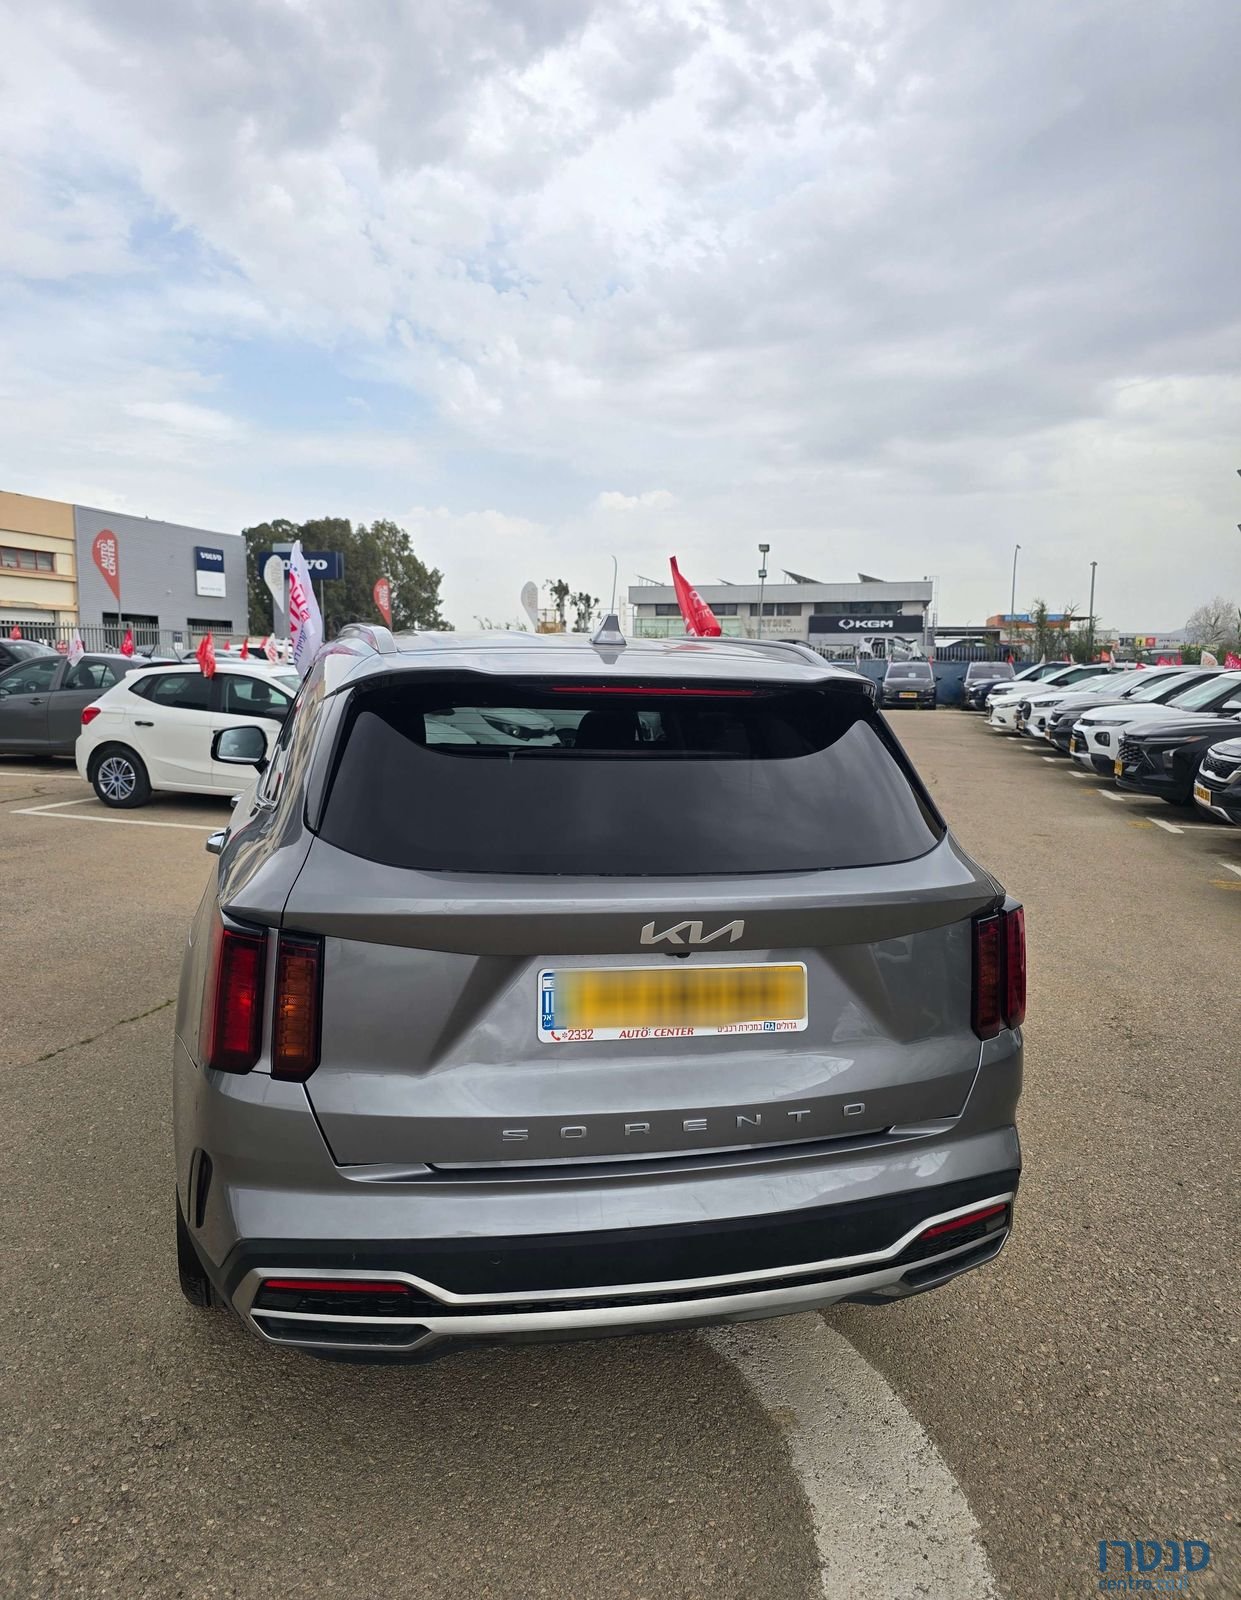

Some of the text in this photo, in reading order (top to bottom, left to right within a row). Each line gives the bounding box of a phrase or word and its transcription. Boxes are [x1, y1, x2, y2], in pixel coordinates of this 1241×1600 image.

[100, 543, 109, 570] AUTO
[107, 539, 116, 576] CENTER
[200, 552, 222, 561] VOLVO
[855, 620, 893, 628] KGM
[640, 920, 745, 945] KIA
[764, 1022, 775, 1031] גם
[776, 1021, 797, 1030] גדולים
[654, 1027, 694, 1037] CENTER
[502, 1102, 866, 1142] SORENTO
